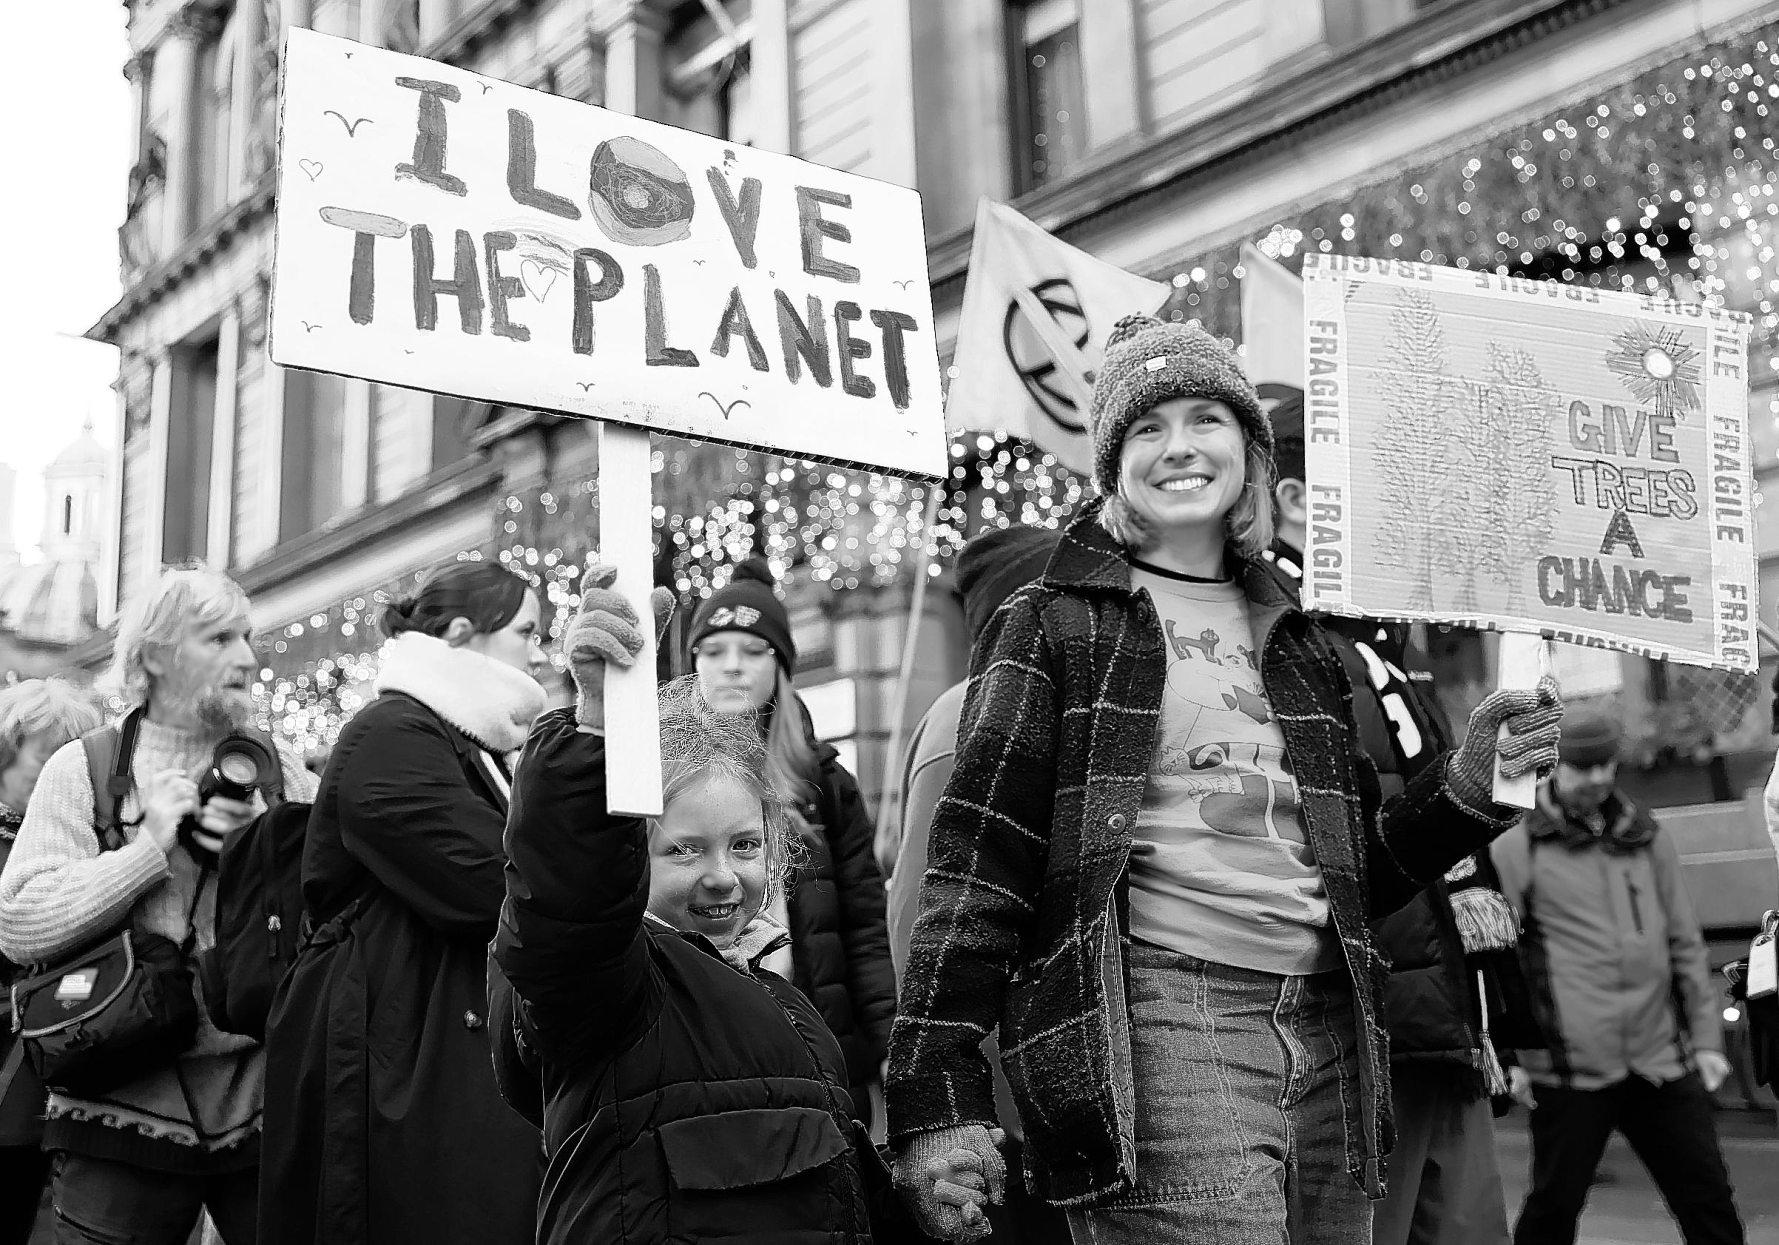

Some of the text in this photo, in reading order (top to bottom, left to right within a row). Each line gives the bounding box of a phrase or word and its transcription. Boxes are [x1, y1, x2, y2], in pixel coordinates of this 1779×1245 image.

[395, 76, 860, 283] I LOVE
[319, 206, 918, 412] THE PLANET
[1308, 320, 1340, 444] FRAGILE
[1568, 400, 1681, 464] GIVE
[1551, 455, 1699, 520] TREES
[1713, 414, 1744, 543] FRAGILE
[1311, 484, 1343, 606] FRAGIL
[1599, 509, 1645, 558] A
[1537, 555, 1694, 623] CHANCE
[1718, 583, 1751, 667] FRAG
